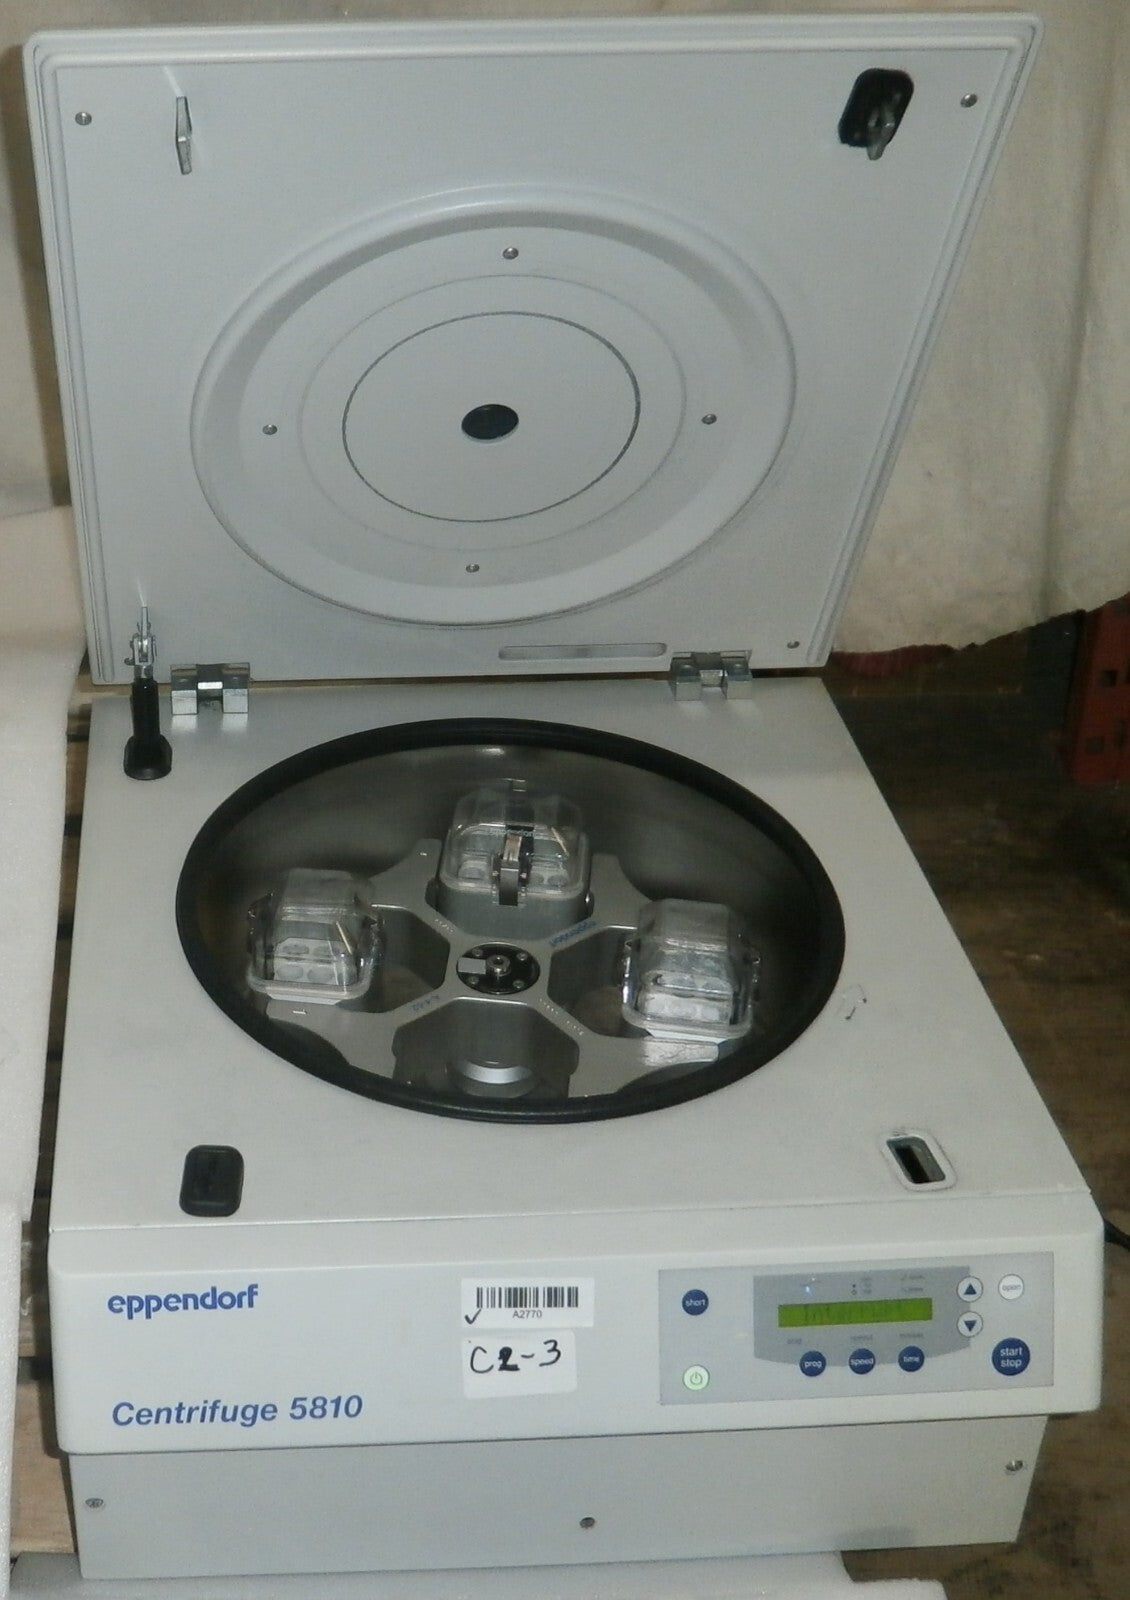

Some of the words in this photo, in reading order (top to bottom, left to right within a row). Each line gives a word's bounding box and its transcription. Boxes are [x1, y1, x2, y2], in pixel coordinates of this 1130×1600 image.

[108, 1284, 258, 1320] eppendorf
[512, 1310, 542, 1319] A2770
[1000, 1347, 1023, 1357] start
[804, 1359, 823, 1369] prog
[851, 1356, 874, 1366] speed
[1001, 1358, 1022, 1368] stop
[112, 1399, 278, 1427] Centrifuge
[289, 1394, 363, 1420] 5810
